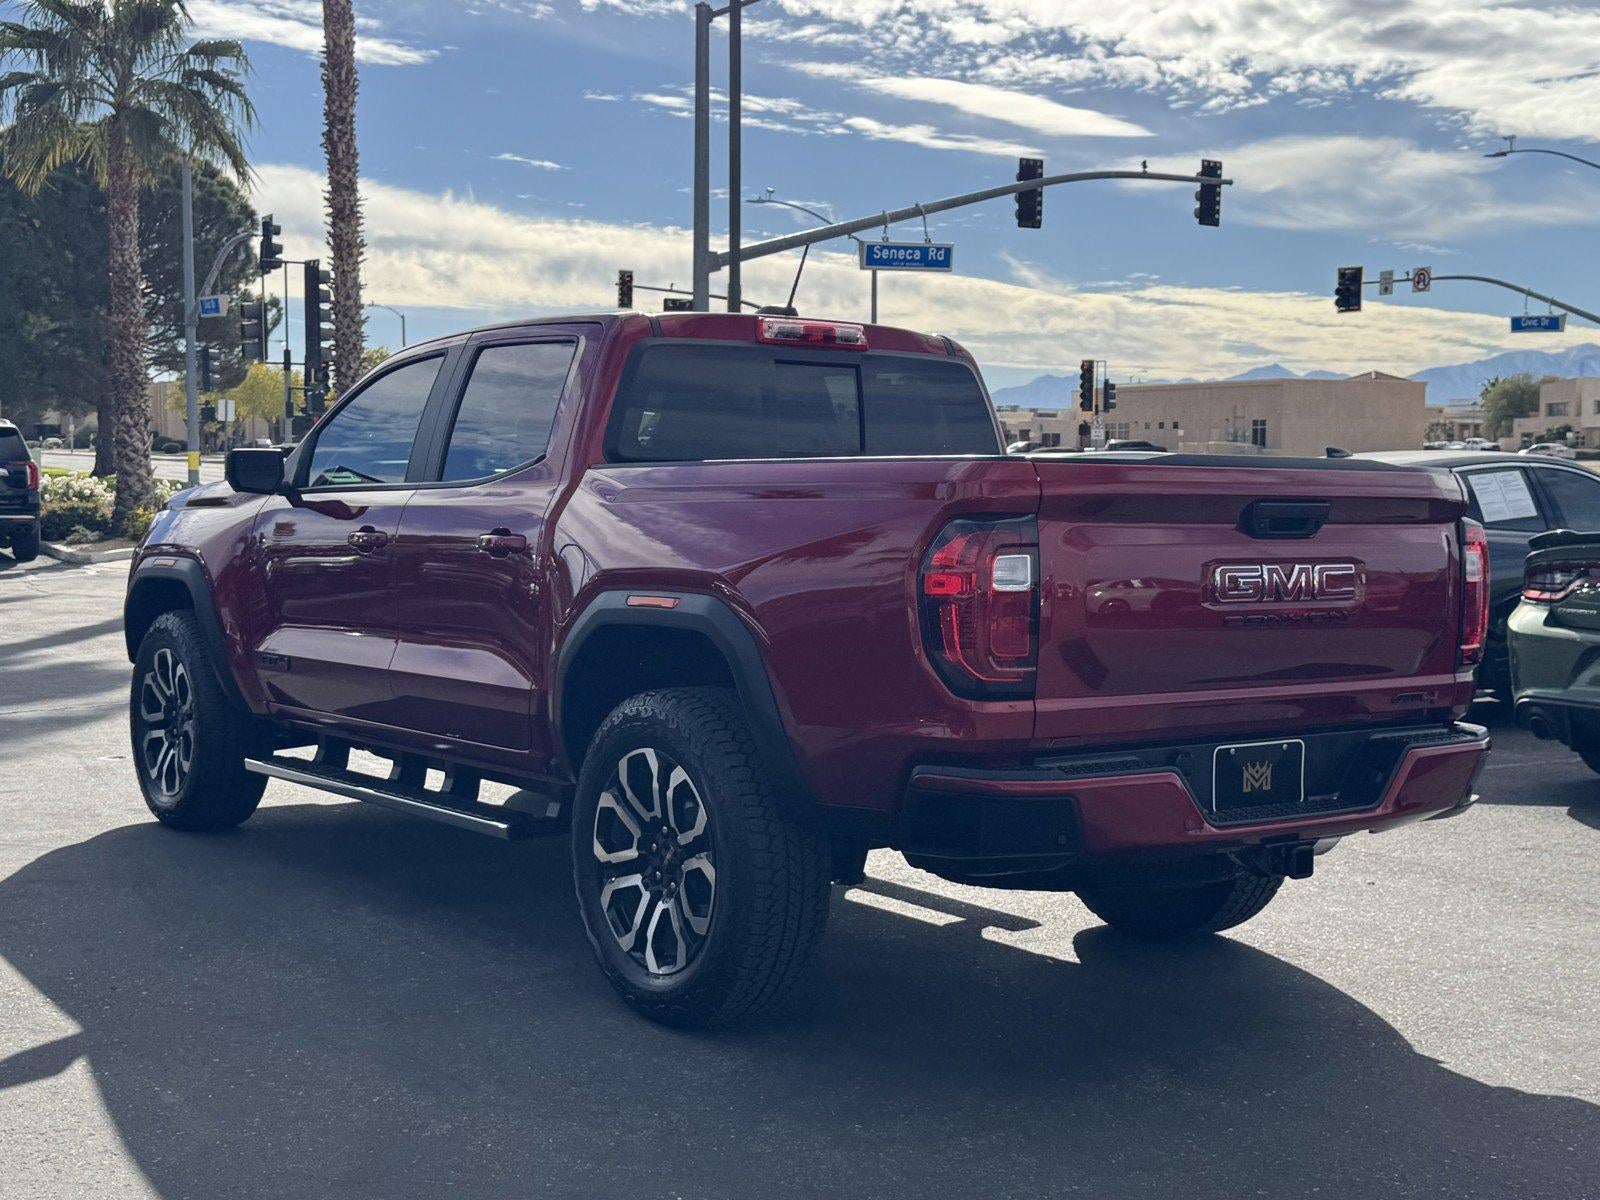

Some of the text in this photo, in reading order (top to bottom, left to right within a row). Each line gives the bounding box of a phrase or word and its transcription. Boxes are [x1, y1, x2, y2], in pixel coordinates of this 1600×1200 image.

[873, 245, 945, 261] Seneca Rd
[1214, 563, 1356, 603] GMC
